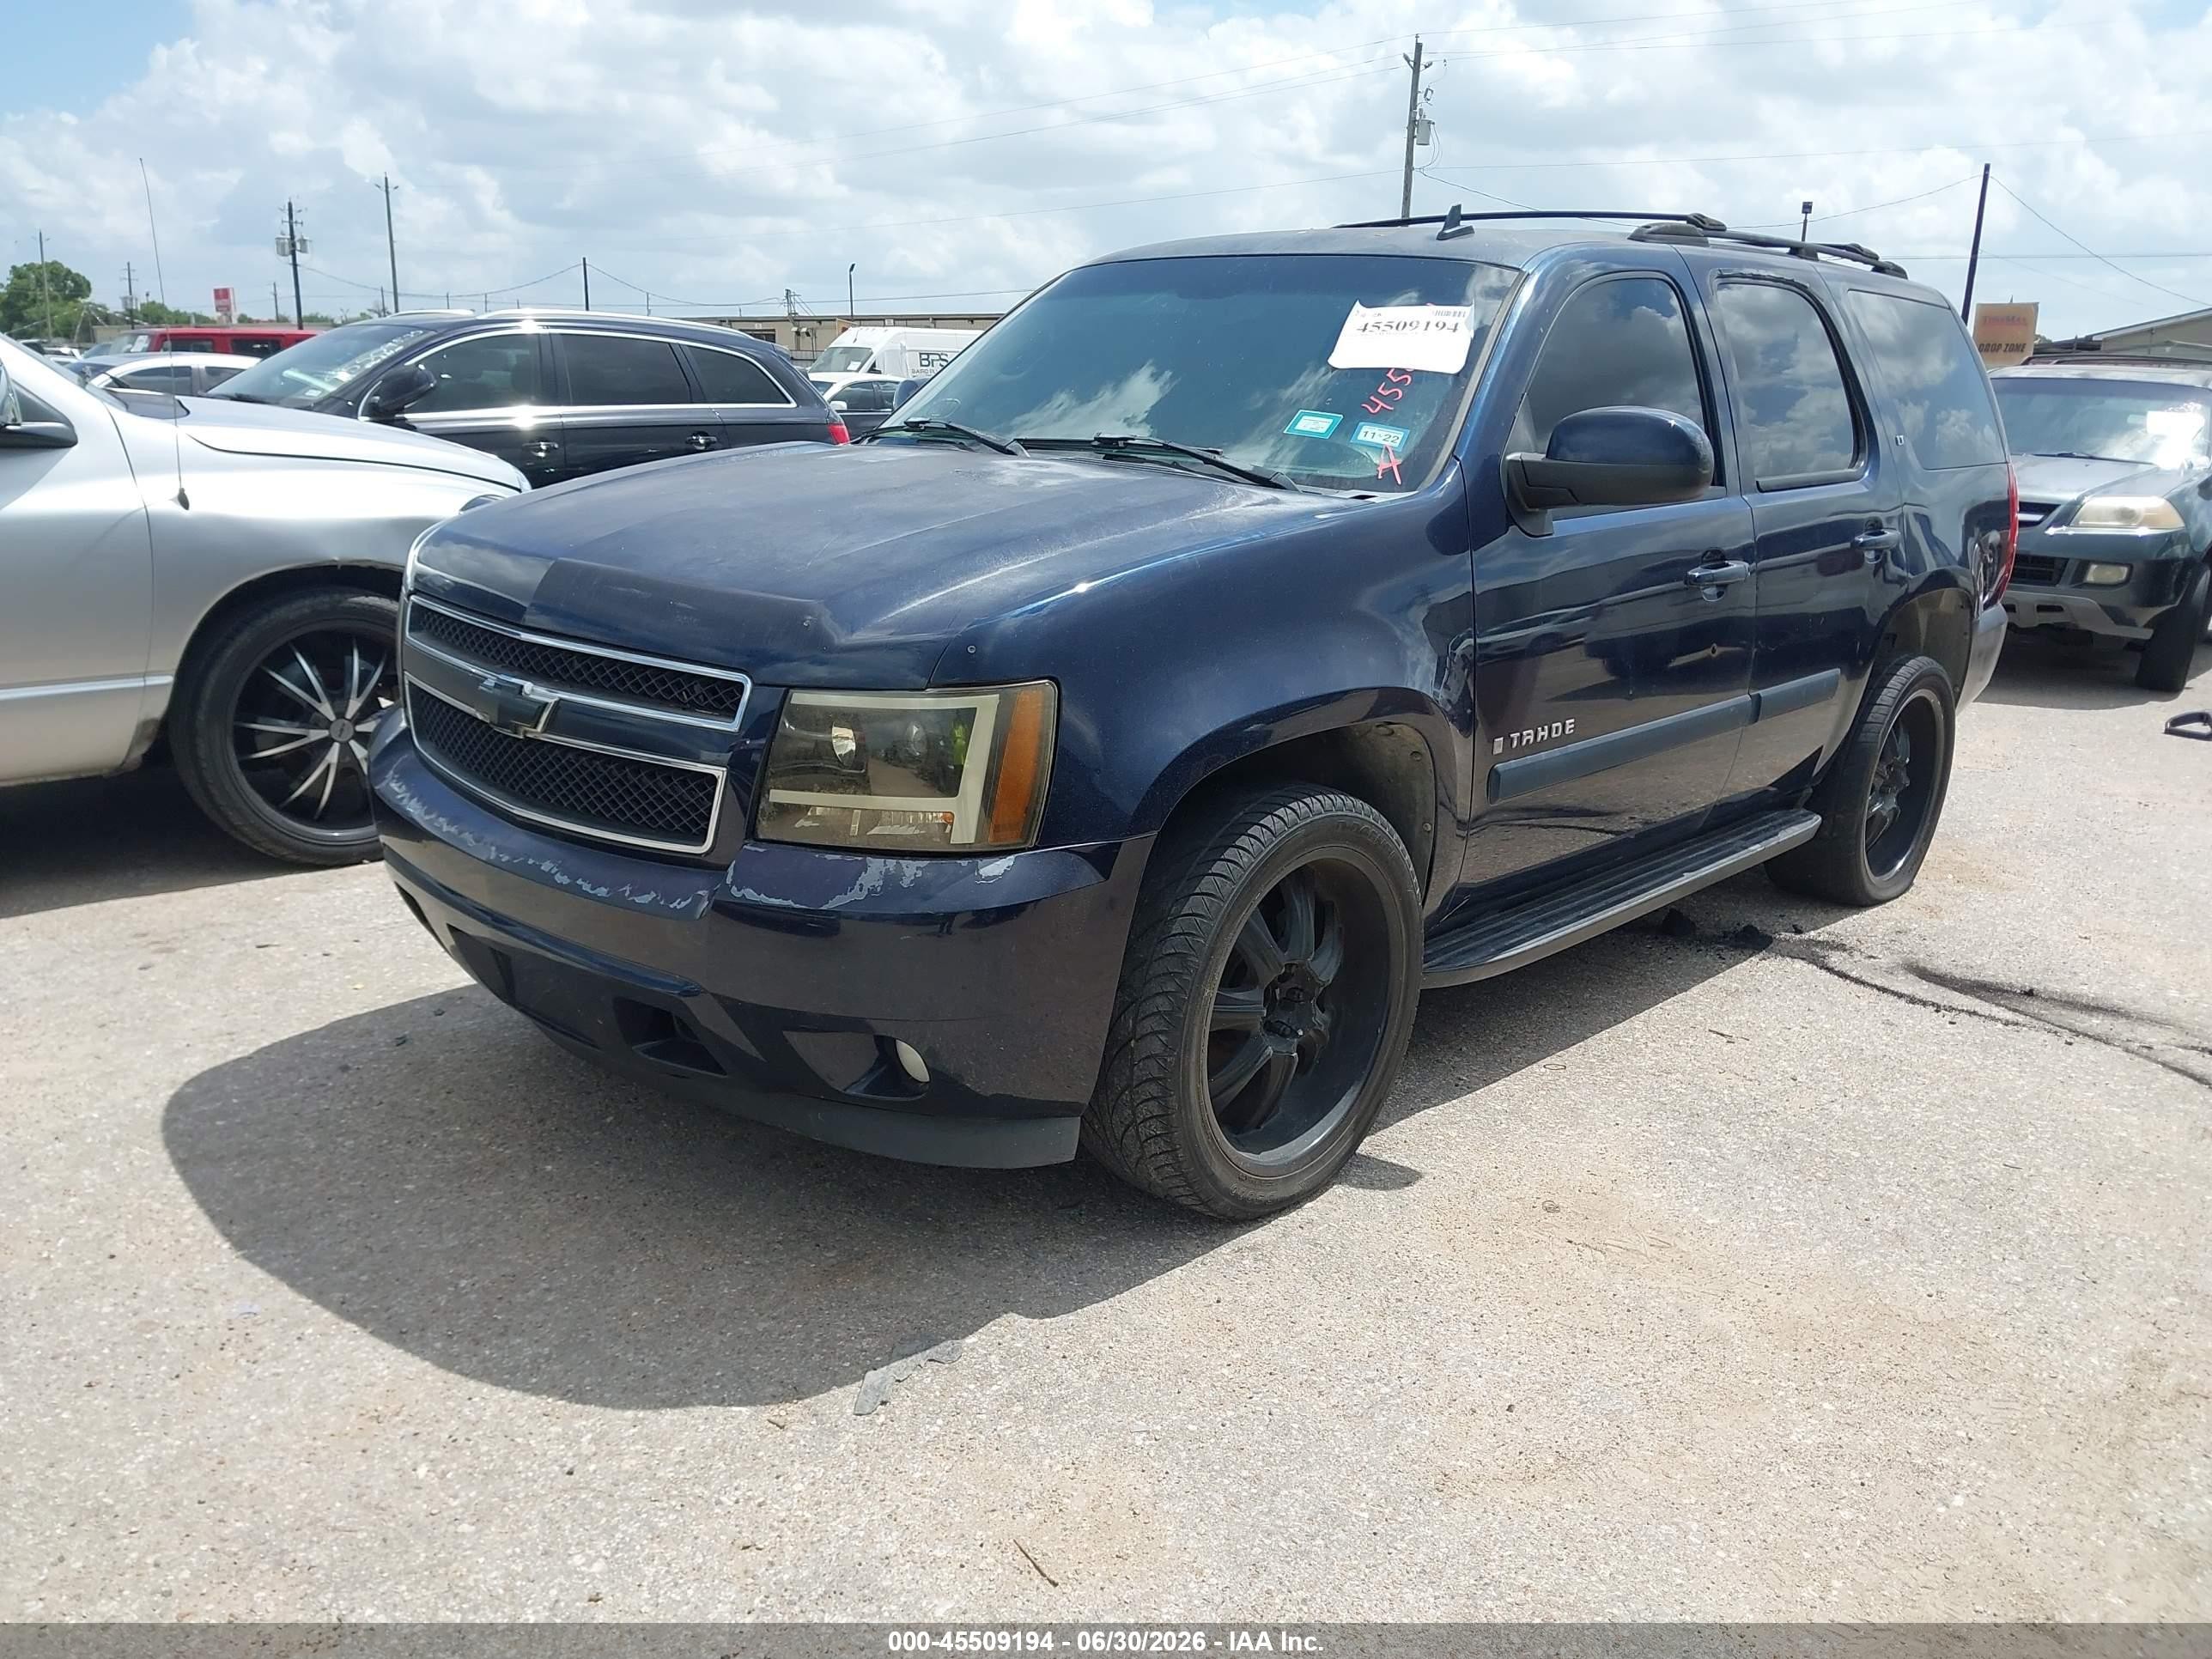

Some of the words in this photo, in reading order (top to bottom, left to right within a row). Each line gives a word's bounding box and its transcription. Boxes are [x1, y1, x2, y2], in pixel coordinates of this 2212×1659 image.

[1356, 319, 1460, 333] 45509194
[1978, 343, 2002, 353] DROP
[2003, 343, 2027, 353] ZONE
[919, 352, 949, 368] BPS
[1361, 368, 1415, 414] 455
[1510, 718, 1576, 750] TAHOE
